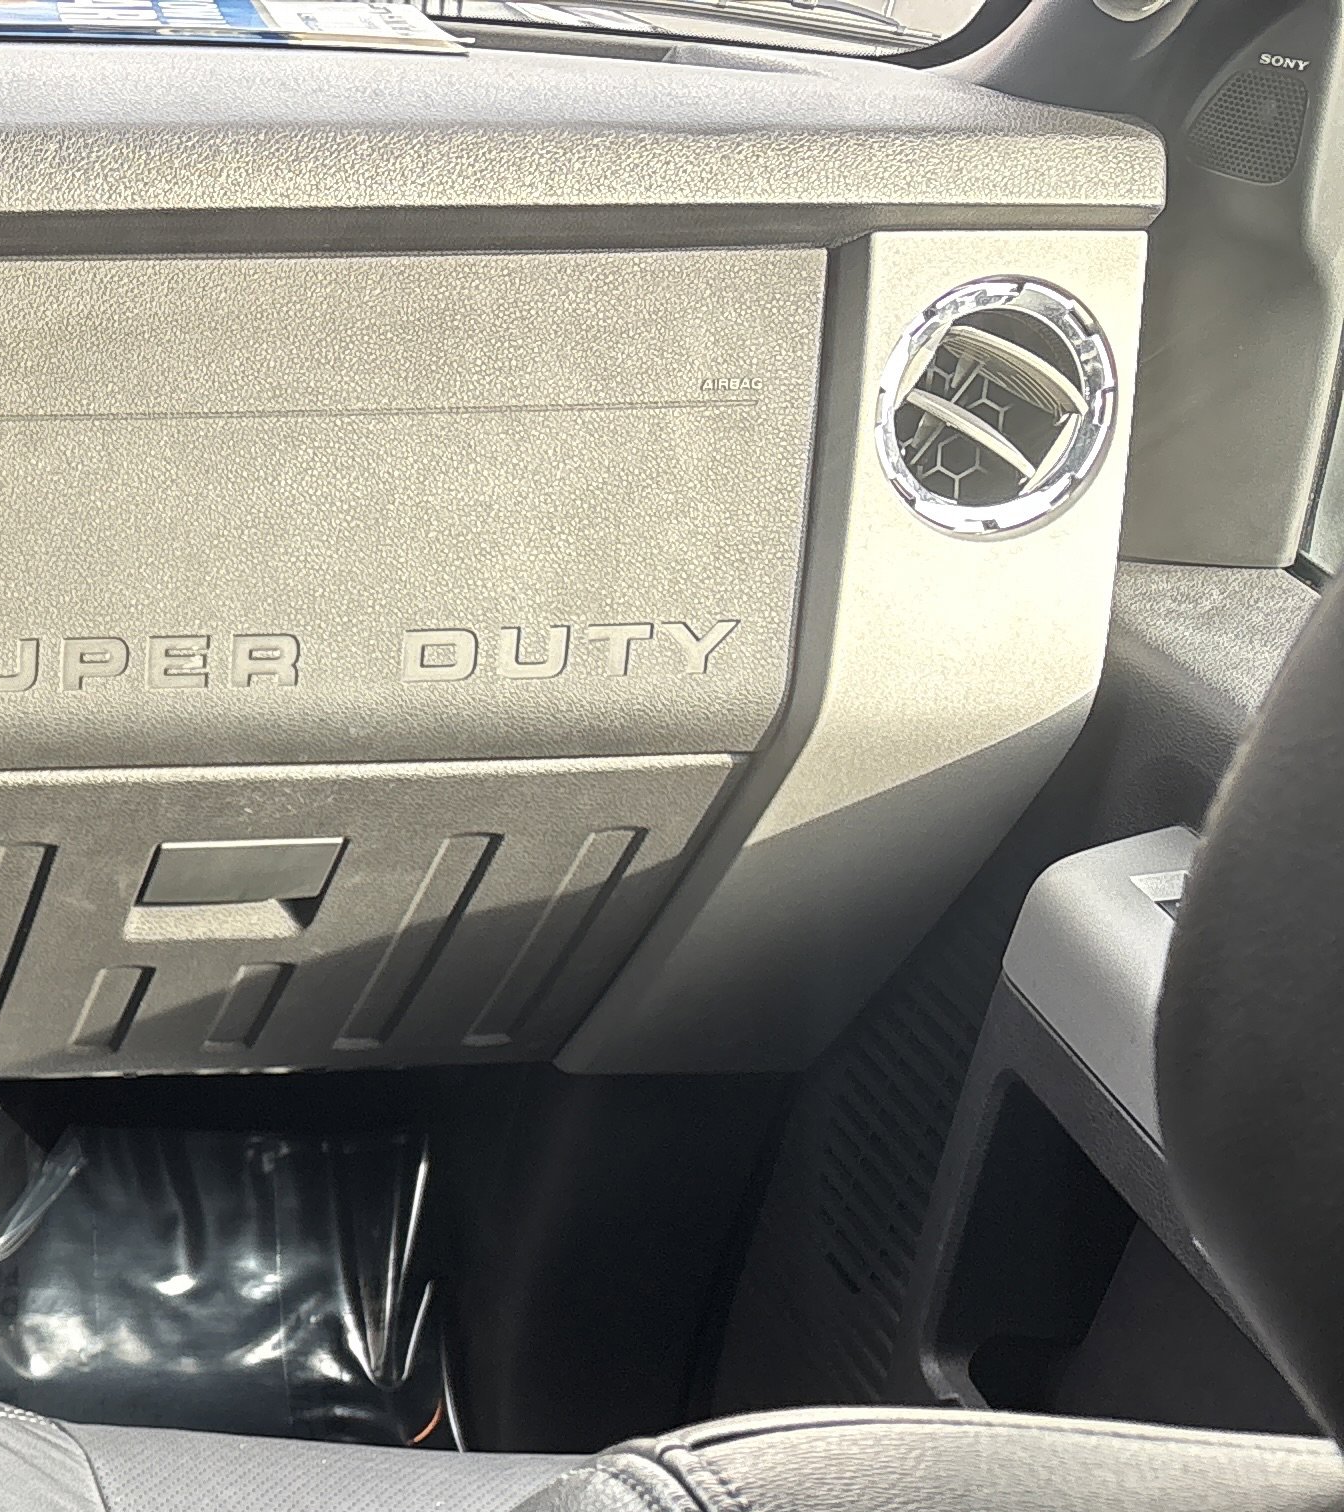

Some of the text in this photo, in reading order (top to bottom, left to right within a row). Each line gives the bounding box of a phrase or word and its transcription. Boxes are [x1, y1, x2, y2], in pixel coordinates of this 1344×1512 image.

[1259, 53, 1310, 71] SONY
[699, 376, 764, 393] AIRBAG
[402, 618, 740, 684] DUTY
